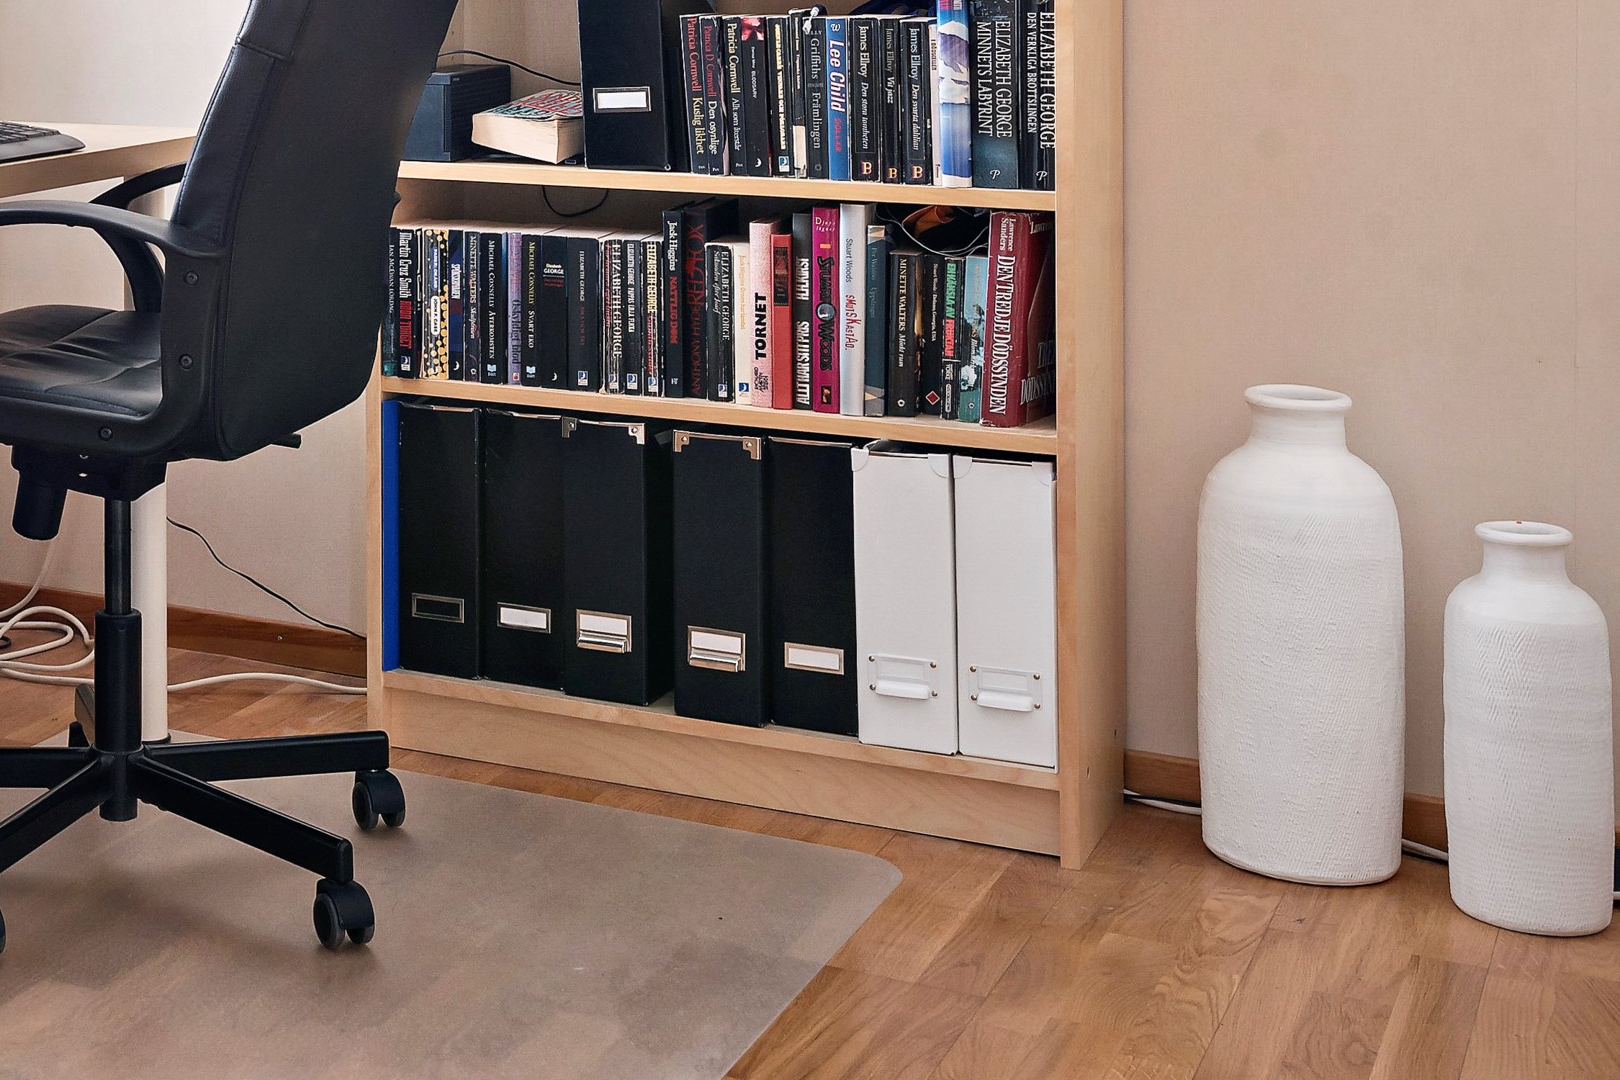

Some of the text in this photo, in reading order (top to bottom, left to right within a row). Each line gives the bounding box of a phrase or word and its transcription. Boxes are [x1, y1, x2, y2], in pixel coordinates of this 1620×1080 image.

[829, 40, 844, 67] Lee
[909, 28, 919, 53] James
[908, 54, 920, 80] Ellroy
[976, 22, 992, 136] MINNETS LABYRINT
[995, 21, 1012, 138] ELIZABETH GEORGE
[687, 17, 705, 154] Patricia Cornwell Kuslig likhet
[810, 38, 821, 149] Griffiths Främlingen
[830, 72, 845, 112] Child
[912, 84, 920, 98] Den
[912, 123, 920, 150] dahlian
[912, 166, 923, 178] B
[667, 221, 677, 238] Jack
[999, 218, 1009, 250] Sanders
[399, 233, 412, 257] Martin
[668, 240, 677, 271] Higgins
[399, 259, 412, 276] Cruz
[399, 278, 412, 298] Smith
[400, 322, 412, 349] TORGET
[670, 321, 678, 344] DOM
[755, 293, 767, 360] TORNET
[989, 255, 1015, 414] DEN TREDJE DÖDSSYNDEN
[898, 333, 906, 351] Mörkt
